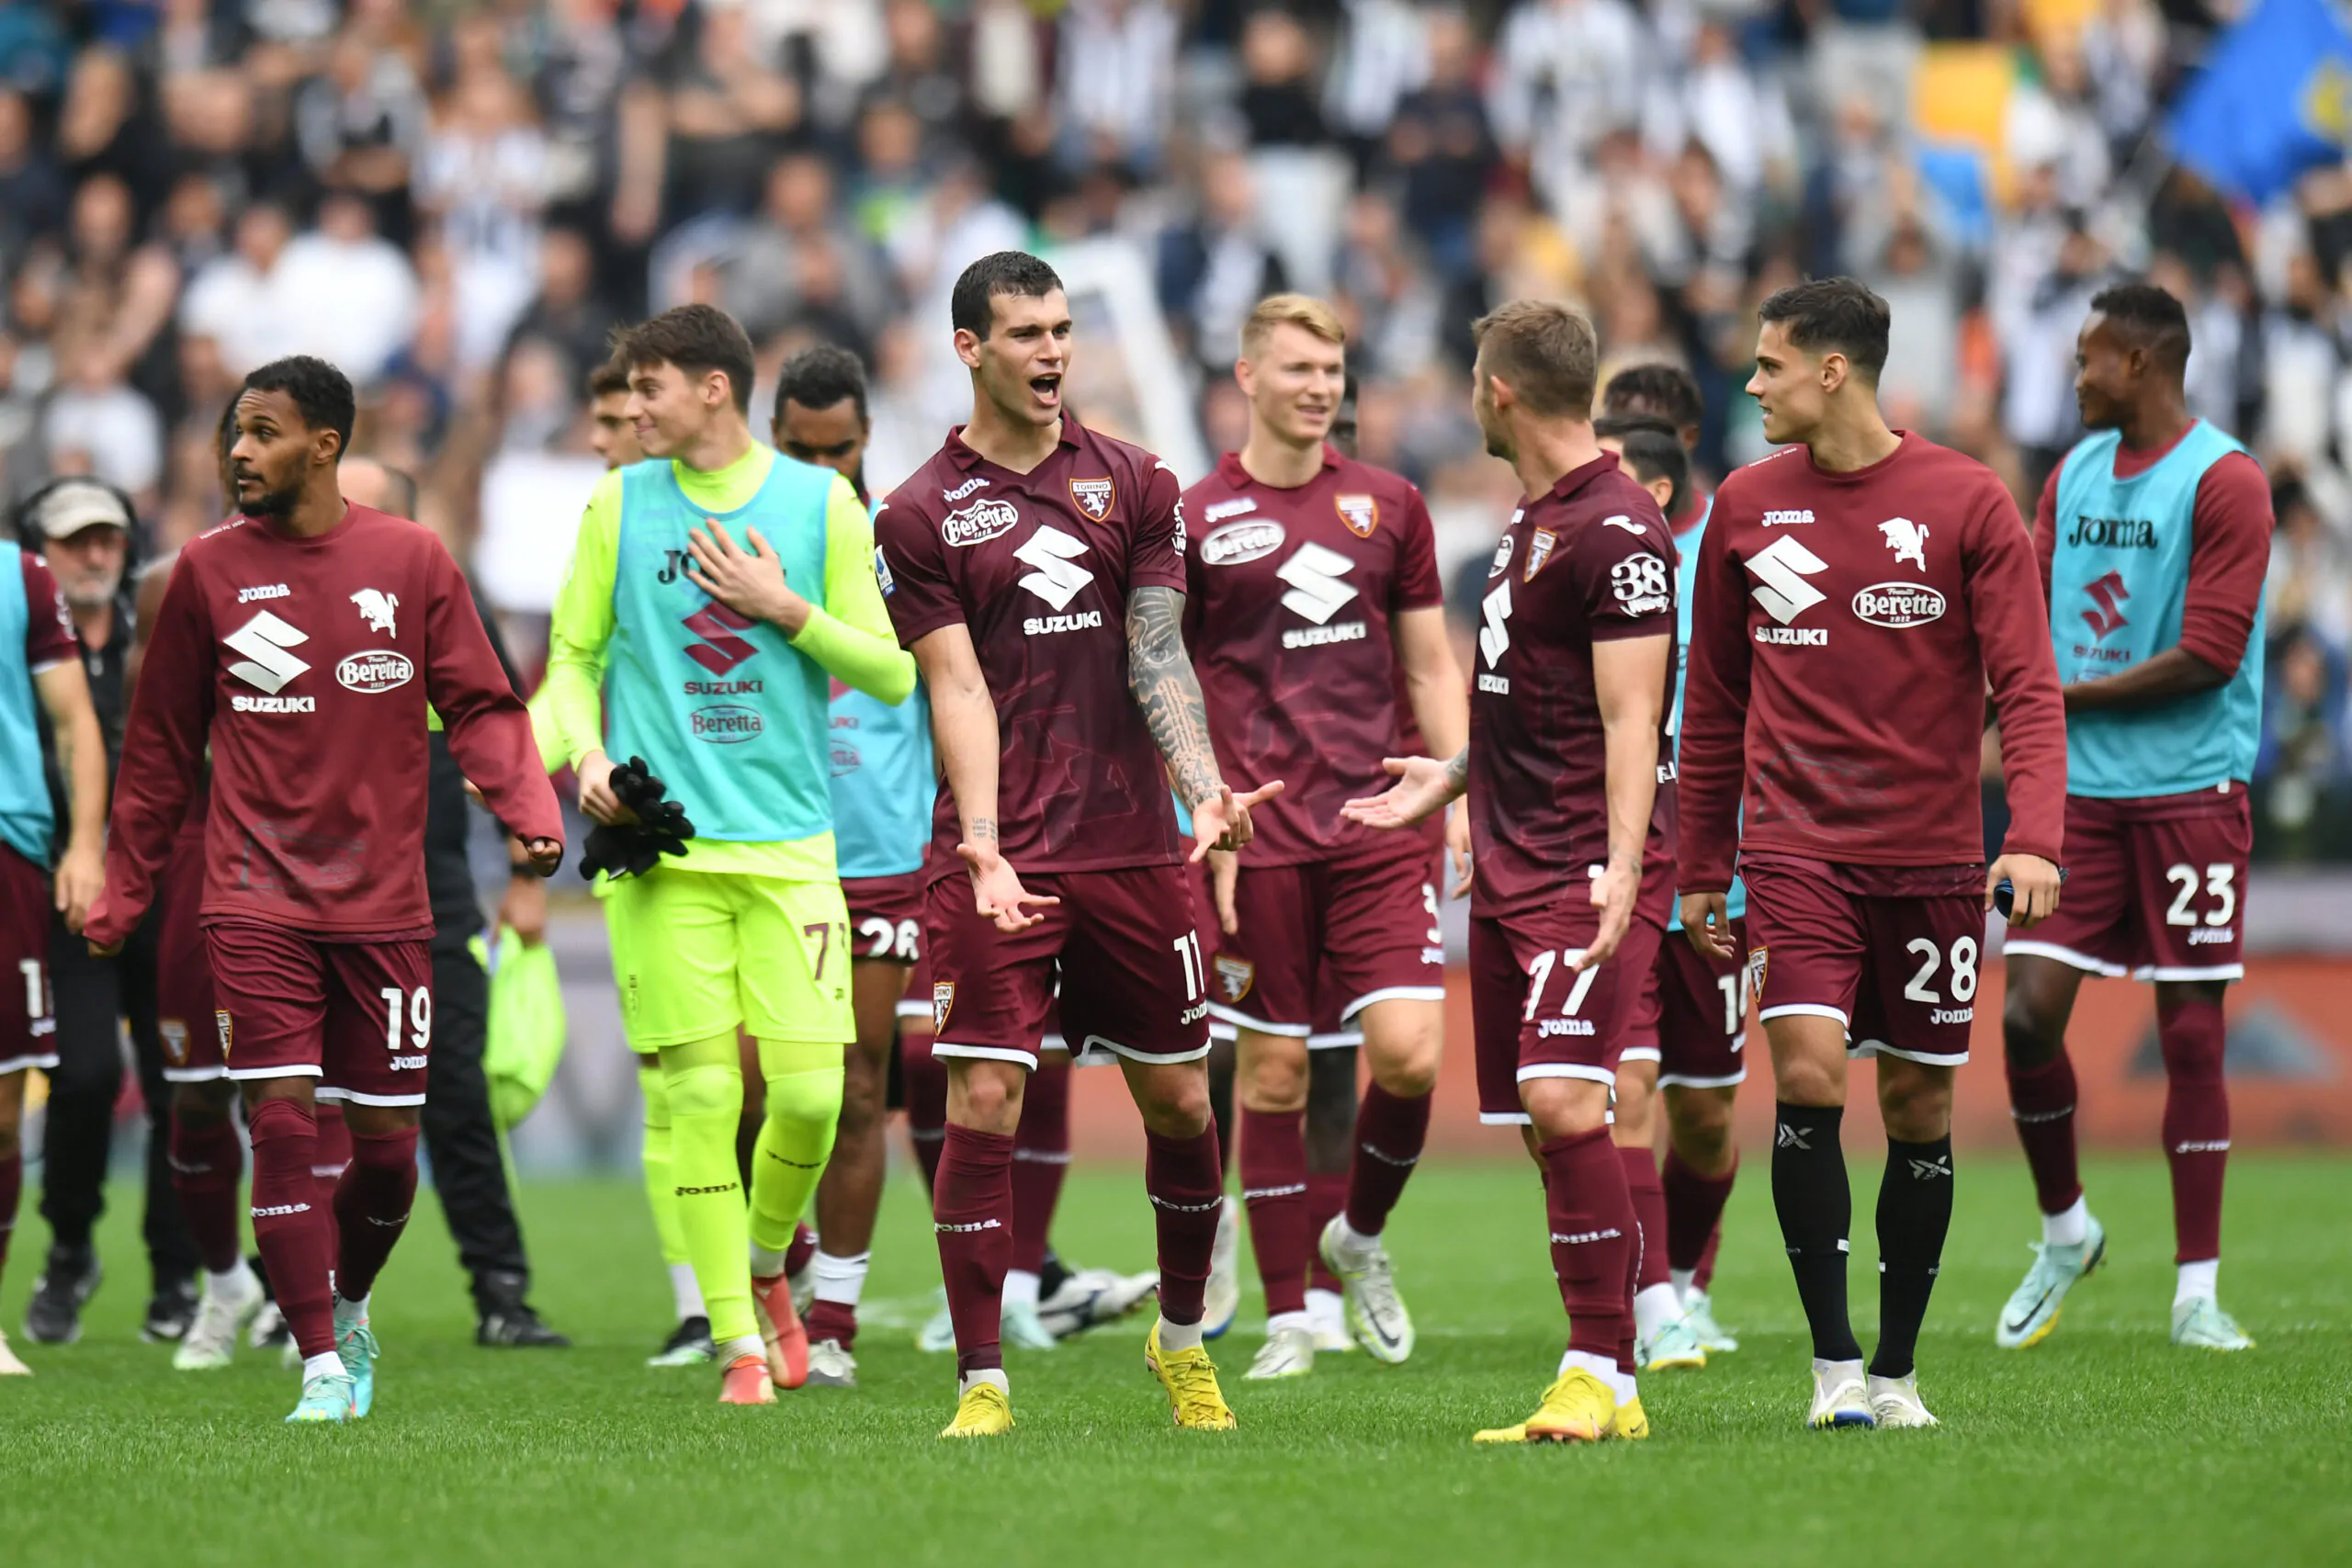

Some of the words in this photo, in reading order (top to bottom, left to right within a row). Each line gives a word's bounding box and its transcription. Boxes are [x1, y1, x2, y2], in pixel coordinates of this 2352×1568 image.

[1076, 482, 1109, 491] TORINO
[946, 505, 1015, 544] Beretta
[1762, 510, 1815, 527] Joma
[2068, 515, 2158, 551] Joma
[1611, 560, 1668, 602] 38
[1859, 592, 1943, 617] Beretta
[1023, 611, 1102, 636] SUZUKI
[1282, 622, 1367, 649] SUZUKI
[1755, 627, 1828, 646] SUZUKI
[341, 661, 411, 686] Beretta
[684, 680, 763, 696] SUZUKI
[232, 695, 316, 713] SUZUKI
[691, 713, 763, 735] Beretta
[2166, 863, 2235, 927] 23
[1173, 929, 1205, 1002] 11
[1904, 935, 1978, 1004] 28
[381, 986, 432, 1050] 19
[1537, 1018, 1597, 1039] Joma
